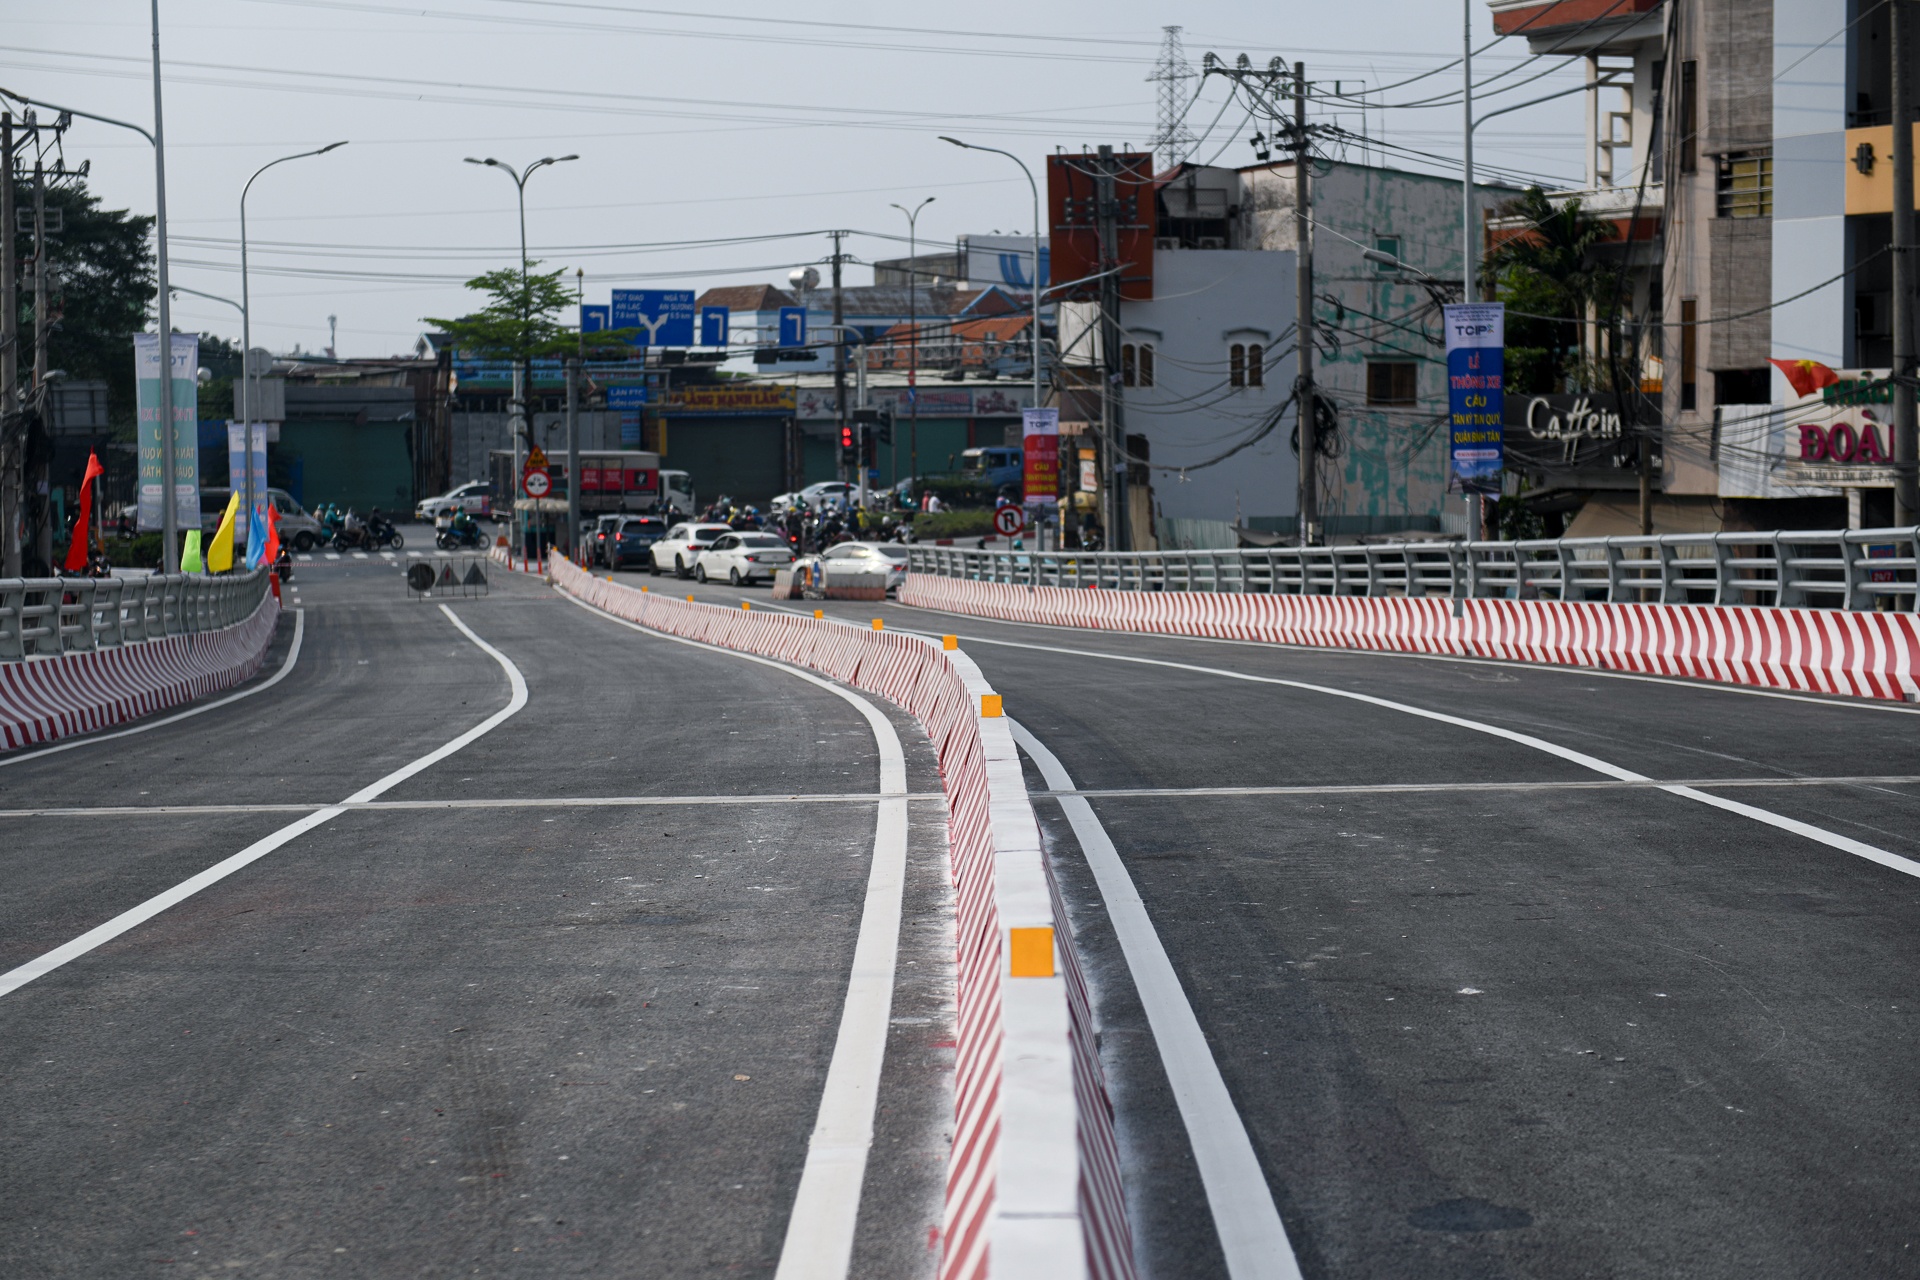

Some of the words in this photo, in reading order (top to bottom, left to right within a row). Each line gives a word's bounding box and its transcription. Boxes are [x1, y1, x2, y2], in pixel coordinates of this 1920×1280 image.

[1455, 325, 1487, 336] TCIP
[1450, 373, 1485, 389] THÔNG
[1487, 375, 1501, 389] XE
[1465, 393, 1487, 408] CẦU
[1527, 397, 1622, 466] Caffein
